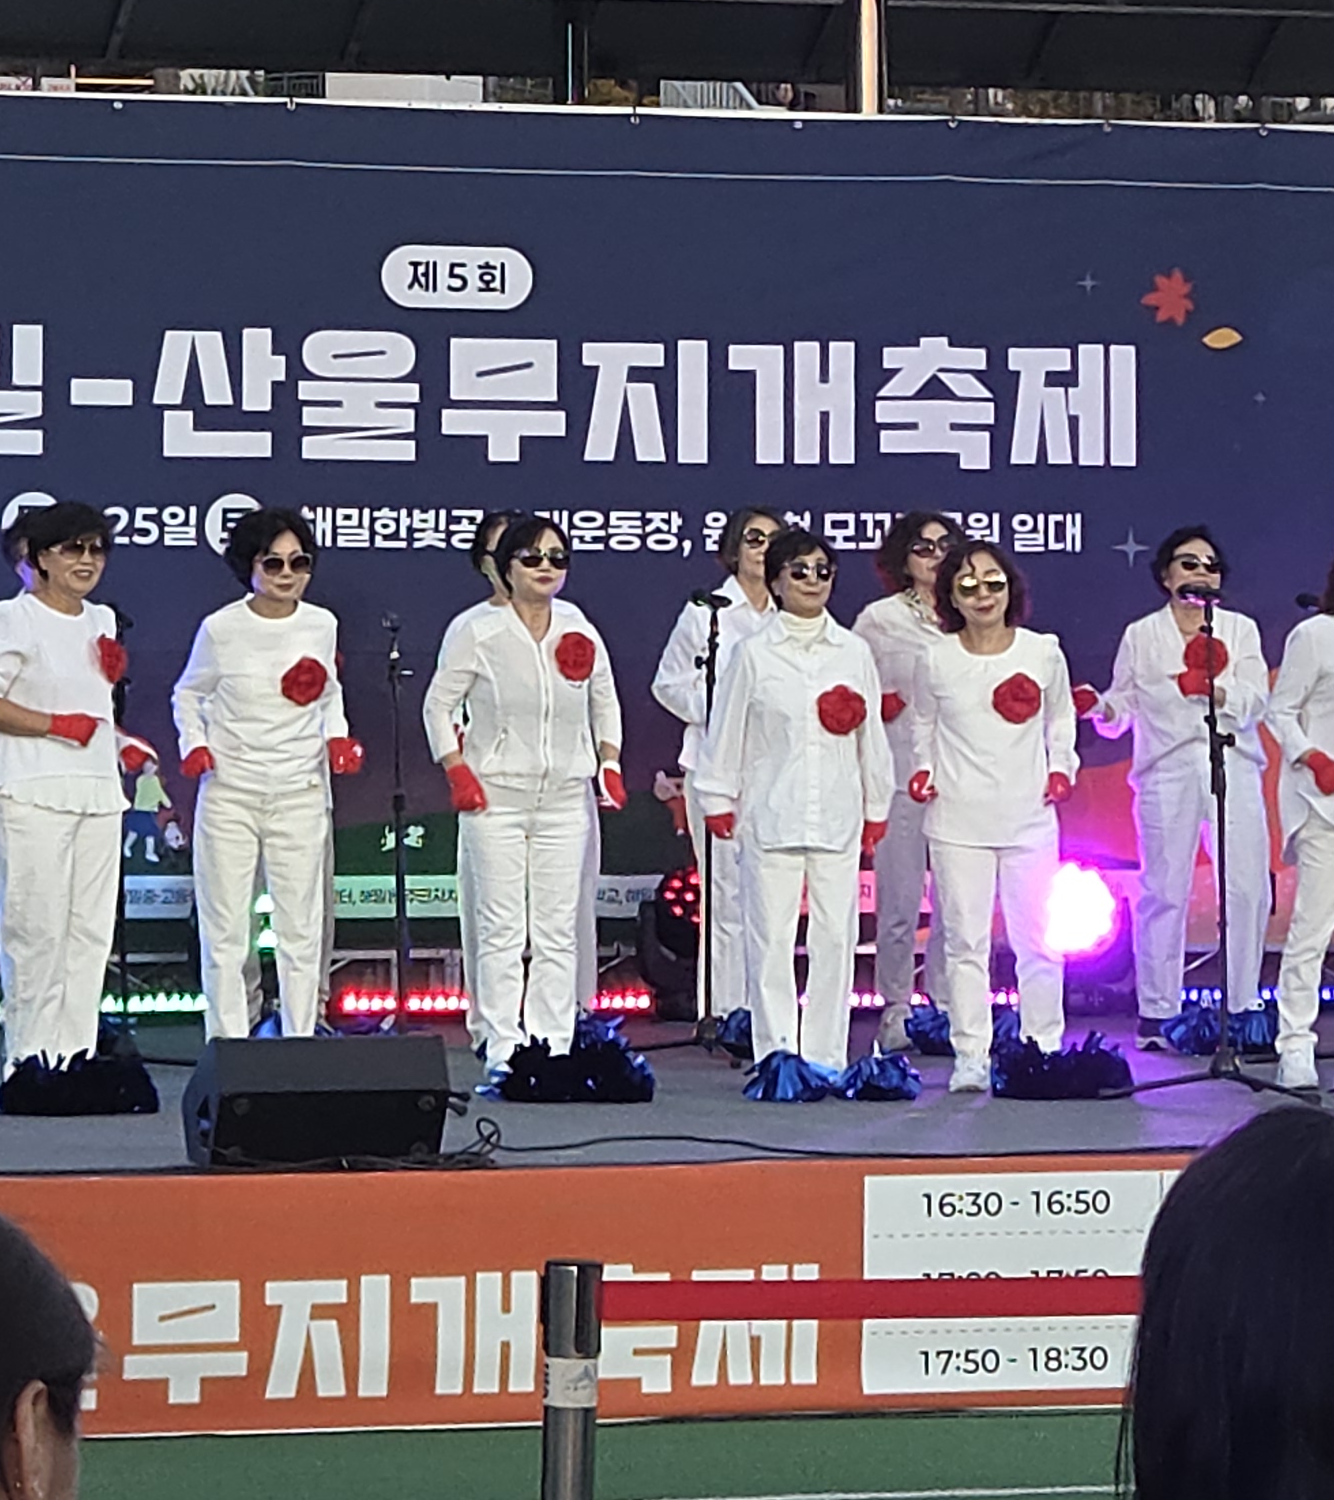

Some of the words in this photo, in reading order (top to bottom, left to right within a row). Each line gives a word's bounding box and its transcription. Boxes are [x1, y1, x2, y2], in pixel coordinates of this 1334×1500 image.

[1011, 512, 1083, 553] 일대
[921, 1191, 1004, 1218] 16:30
[1030, 1189, 1111, 1217] 16:50
[918, 1348, 1001, 1376] 17:50
[1027, 1345, 1110, 1374] 18:30
